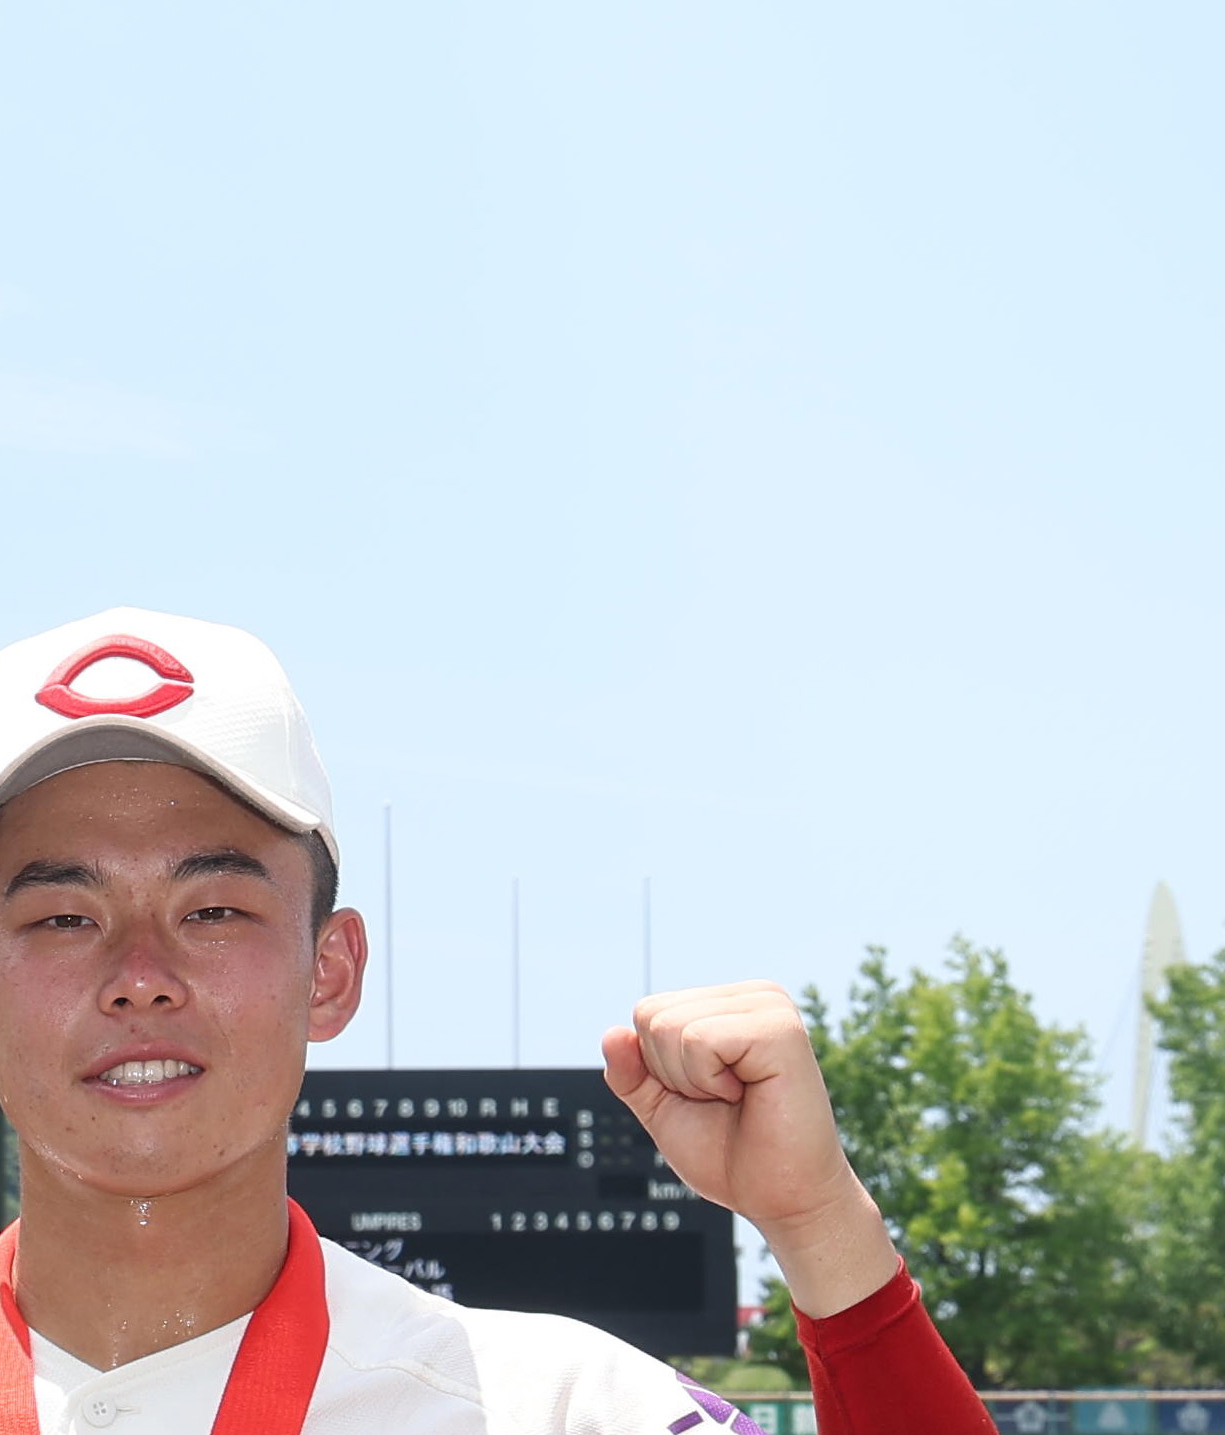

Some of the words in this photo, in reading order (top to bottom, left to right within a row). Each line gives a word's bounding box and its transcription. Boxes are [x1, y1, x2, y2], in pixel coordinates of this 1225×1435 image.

[297, 1098, 310, 1118] 4
[323, 1098, 337, 1118] 5
[347, 1098, 363, 1118] 6
[375, 1098, 388, 1118] 7
[398, 1098, 414, 1118] 8
[424, 1098, 440, 1118] 9
[448, 1098, 468, 1118] 10
[480, 1098, 497, 1118] R
[511, 1098, 528, 1118] H
[543, 1098, 560, 1118] E
[351, 1211, 422, 1232] UMPIRES
[490, 1211, 502, 1231] 1
[511, 1211, 526, 1231] 2
[533, 1211, 548, 1231] 3
[554, 1211, 569, 1231] 4
[577, 1211, 592, 1231] 5
[597, 1211, 614, 1231] 6
[619, 1211, 636, 1231] 7
[641, 1211, 658, 1231] 8
[662, 1211, 680, 1231] 9
